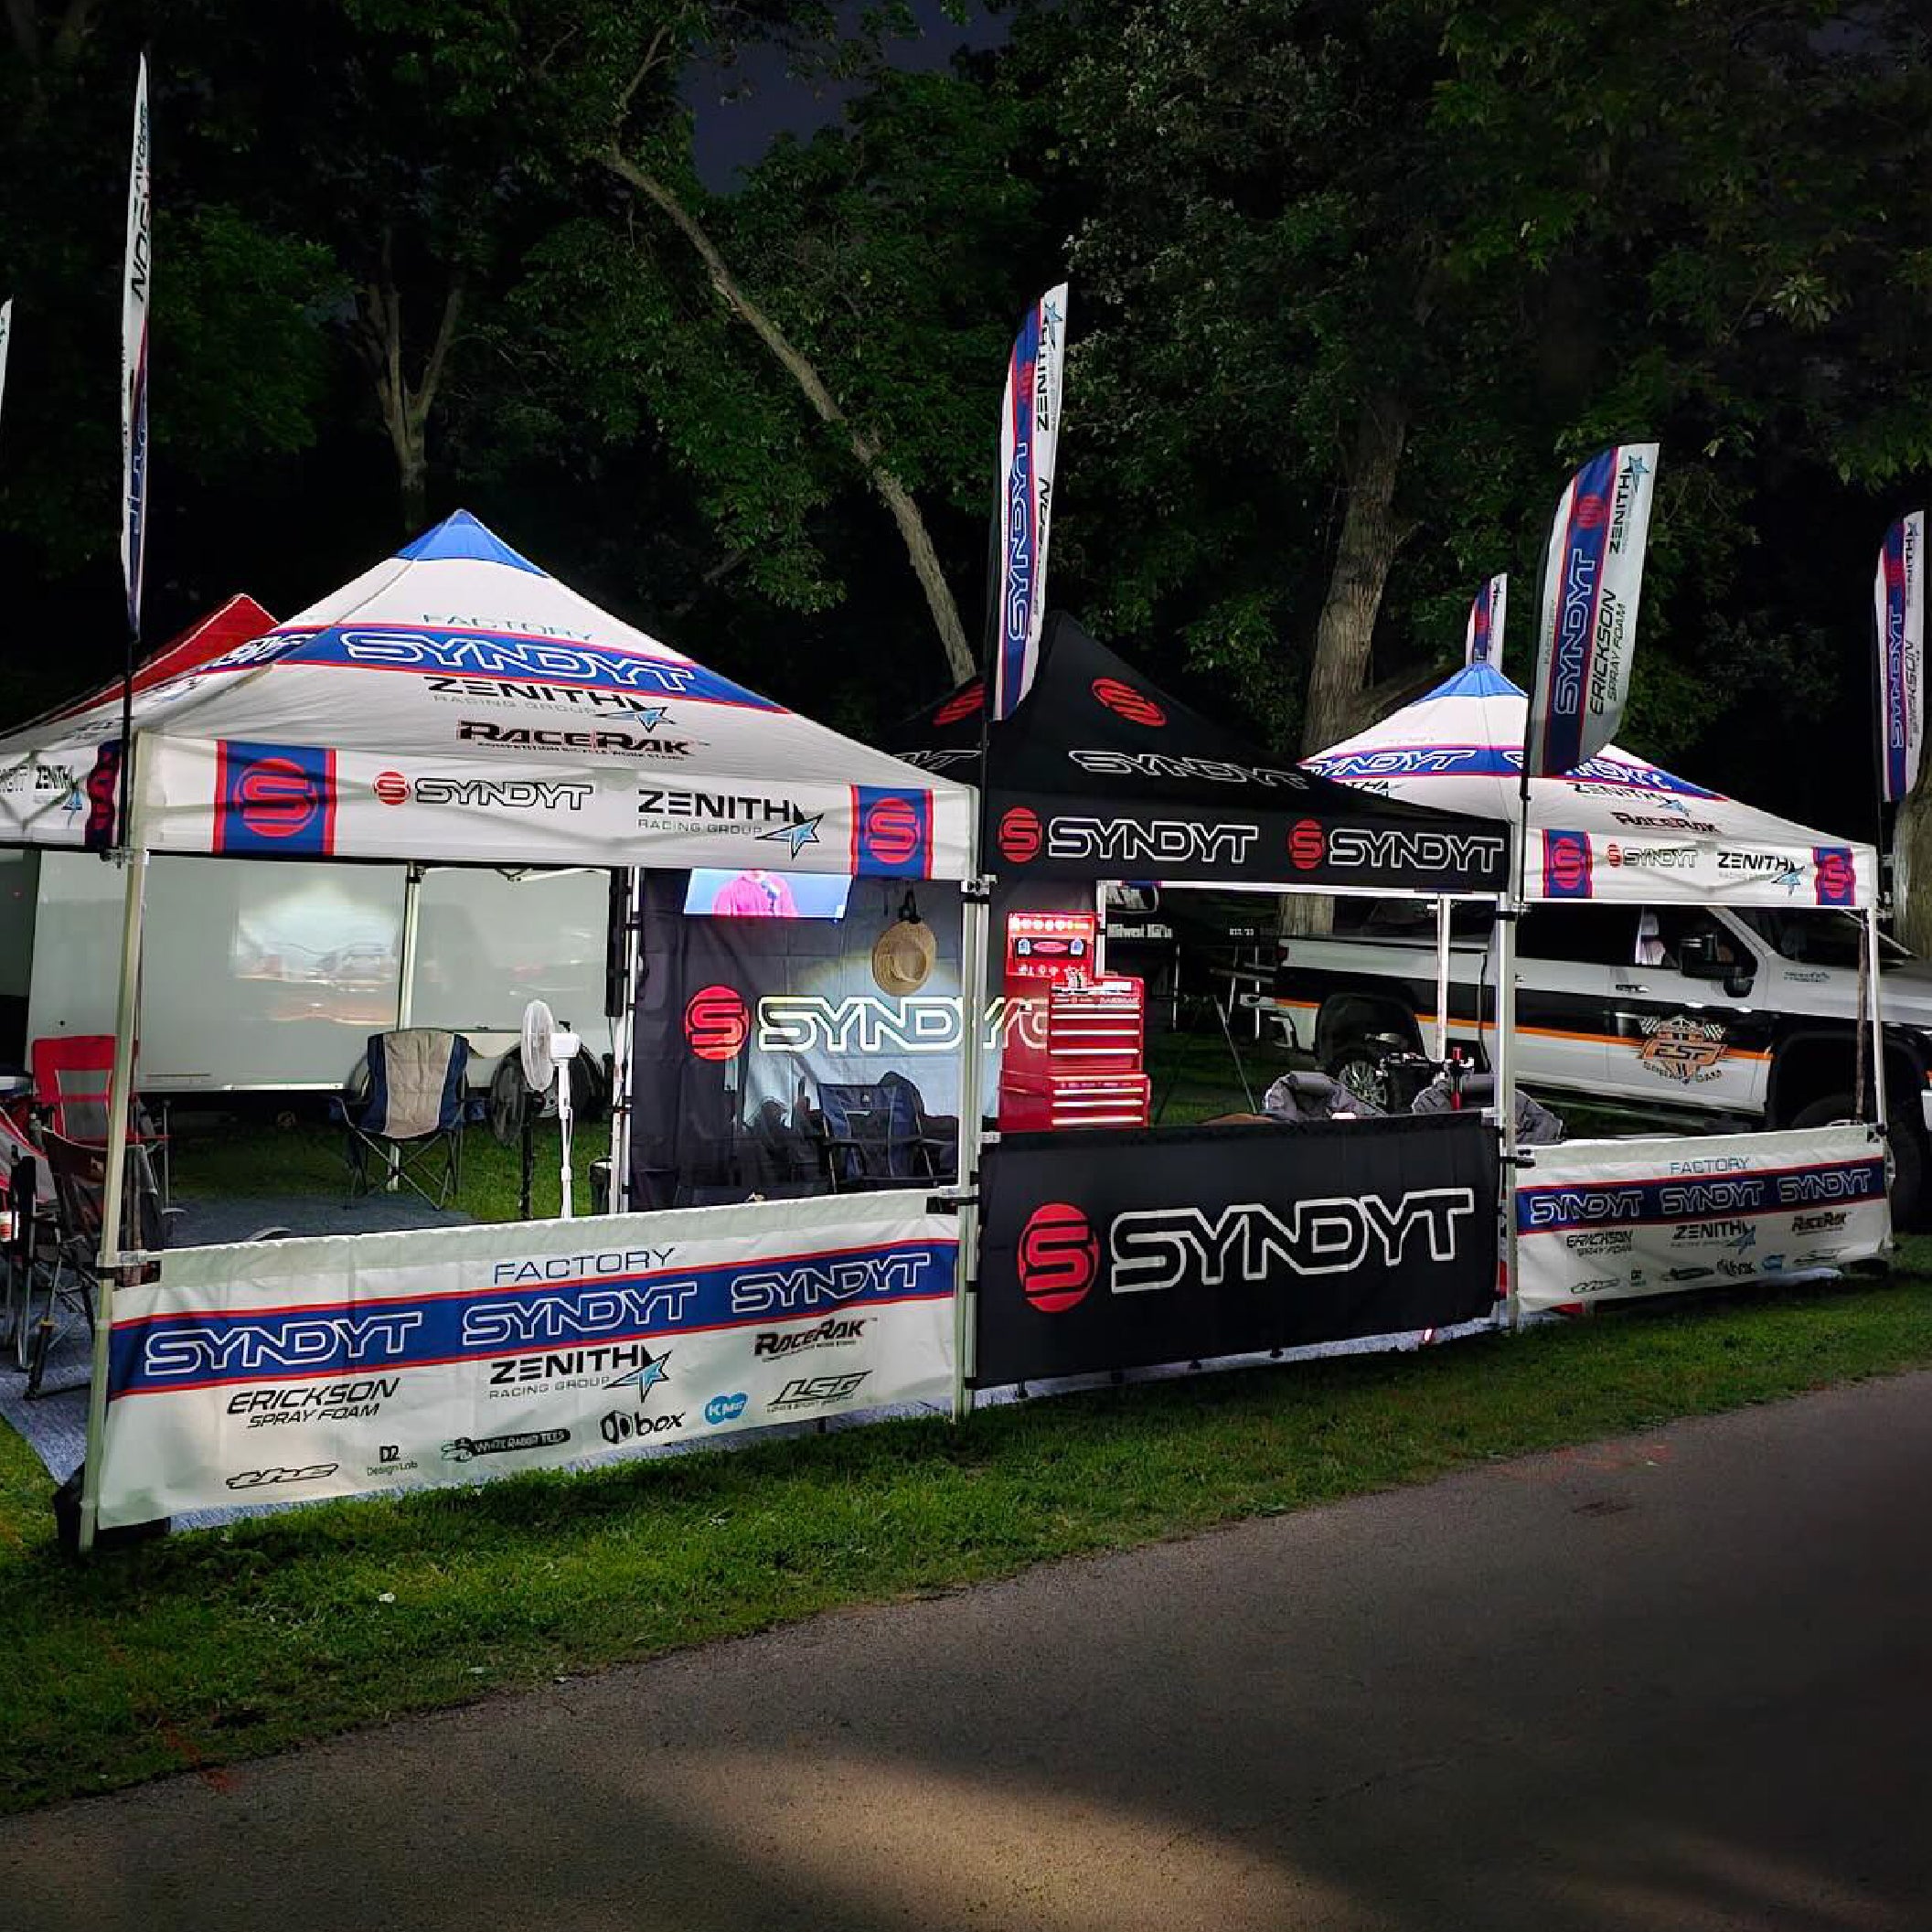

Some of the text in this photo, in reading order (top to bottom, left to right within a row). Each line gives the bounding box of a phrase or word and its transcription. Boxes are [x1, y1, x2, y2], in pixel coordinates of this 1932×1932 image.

[1609, 474, 1631, 555] ZENITH
[1007, 443, 1029, 641] SYNDYT
[1554, 549, 1596, 715] SYNDYT
[1590, 588, 1617, 715] ERICKSON
[339, 631, 695, 692] SYNDYT
[422, 676, 627, 708] ZENITH
[1068, 749, 1310, 790] SYNDYT
[414, 777, 594, 811] SYNDYT
[638, 790, 790, 822] ZENITH
[638, 818, 701, 833] RACING
[1048, 816, 1260, 864] SYNDYT
[1328, 827, 1505, 873] SYNDYT
[1623, 848, 1699, 869] SYNDYT
[1716, 852, 1788, 872] ZENITH
[1670, 1157, 1750, 1175] FACTORY
[1530, 1169, 1873, 1225] SYNDYT SYNDYT SYNDYT
[1110, 1187, 1475, 1295] SYNDYT
[1671, 1222, 1742, 1241] ZENITH
[495, 1247, 677, 1285] FACTORY
[144, 1252, 931, 1375] SYNDYT SYNDYT SYNDYT
[489, 1344, 639, 1385] ZENITH
[226, 1377, 400, 1414] ERICKSON
[489, 1376, 610, 1400] RACING GROUP
[247, 1403, 380, 1429] SPRAY FOAM
